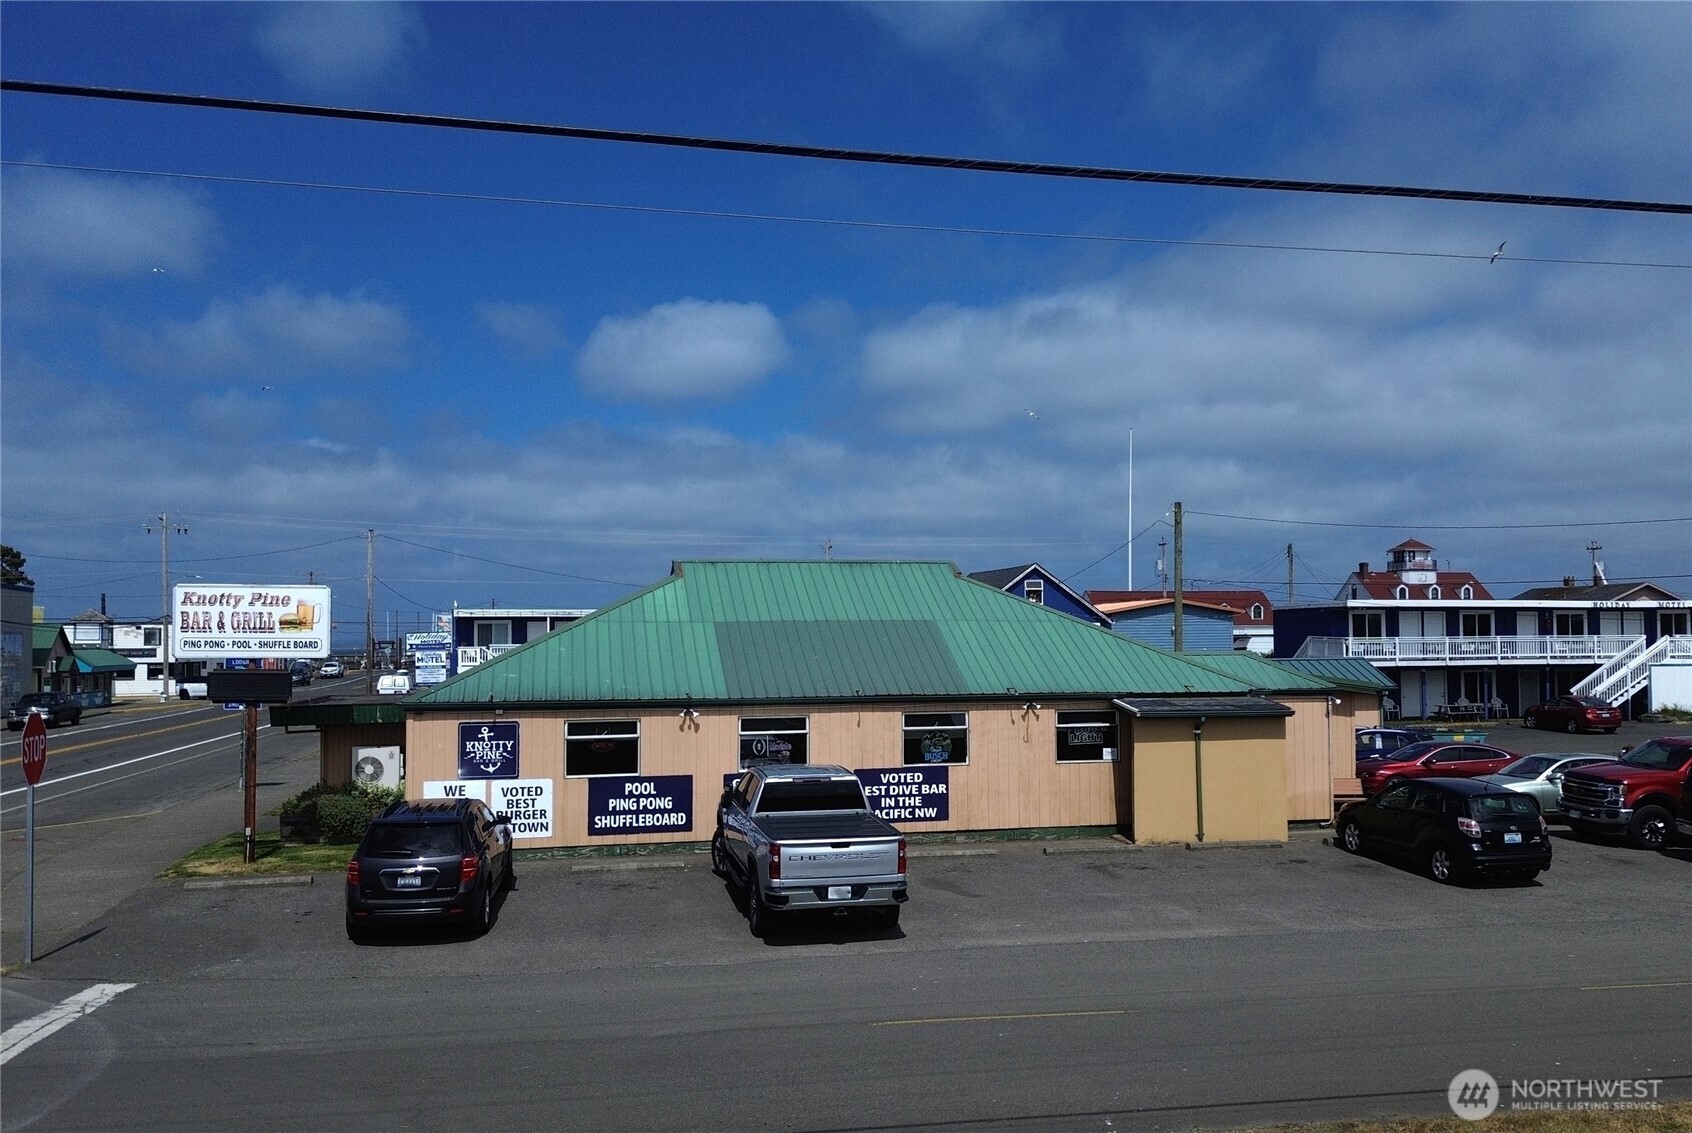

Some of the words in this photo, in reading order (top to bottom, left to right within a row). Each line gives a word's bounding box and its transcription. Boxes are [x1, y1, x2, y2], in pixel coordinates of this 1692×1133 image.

[181, 592, 245, 609] Knotty
[248, 592, 292, 607] Pine
[1592, 601, 1631, 609] HOLIDAY
[180, 611, 213, 633] BAR
[216, 611, 227, 633] &
[230, 611, 276, 633] GRILL
[183, 640, 202, 649] PING
[204, 640, 226, 649] PONG
[231, 640, 251, 649] POOL
[258, 640, 291, 649] SHUFFLE
[293, 640, 319, 649] BOARD
[1070, 733, 1101, 743] LIGHT
[24, 735, 45, 764] STOP
[465, 740, 514, 752] KNOTTY
[475, 751, 503, 760] PINE
[924, 752, 948, 761] BUSCH
[880, 772, 923, 783] VOTED
[443, 785, 466, 797] WE
[501, 786, 544, 798] VOTED
[624, 782, 656, 795] POOL
[864, 785, 887, 796] EST
[889, 785, 919, 795] DIVE
[921, 784, 947, 794] BAR
[506, 798, 537, 809] BEST
[608, 798, 637, 811] PING
[639, 796, 673, 810] PONG
[881, 797, 895, 807] IN
[897, 796, 923, 807] THE
[874, 808, 913, 819] ACIFIC
[915, 807, 937, 818] NW
[594, 812, 686, 828] SHUFFLEBOARD
[511, 821, 549, 833] TOWN
[788, 852, 891, 862] CHEVROLET
